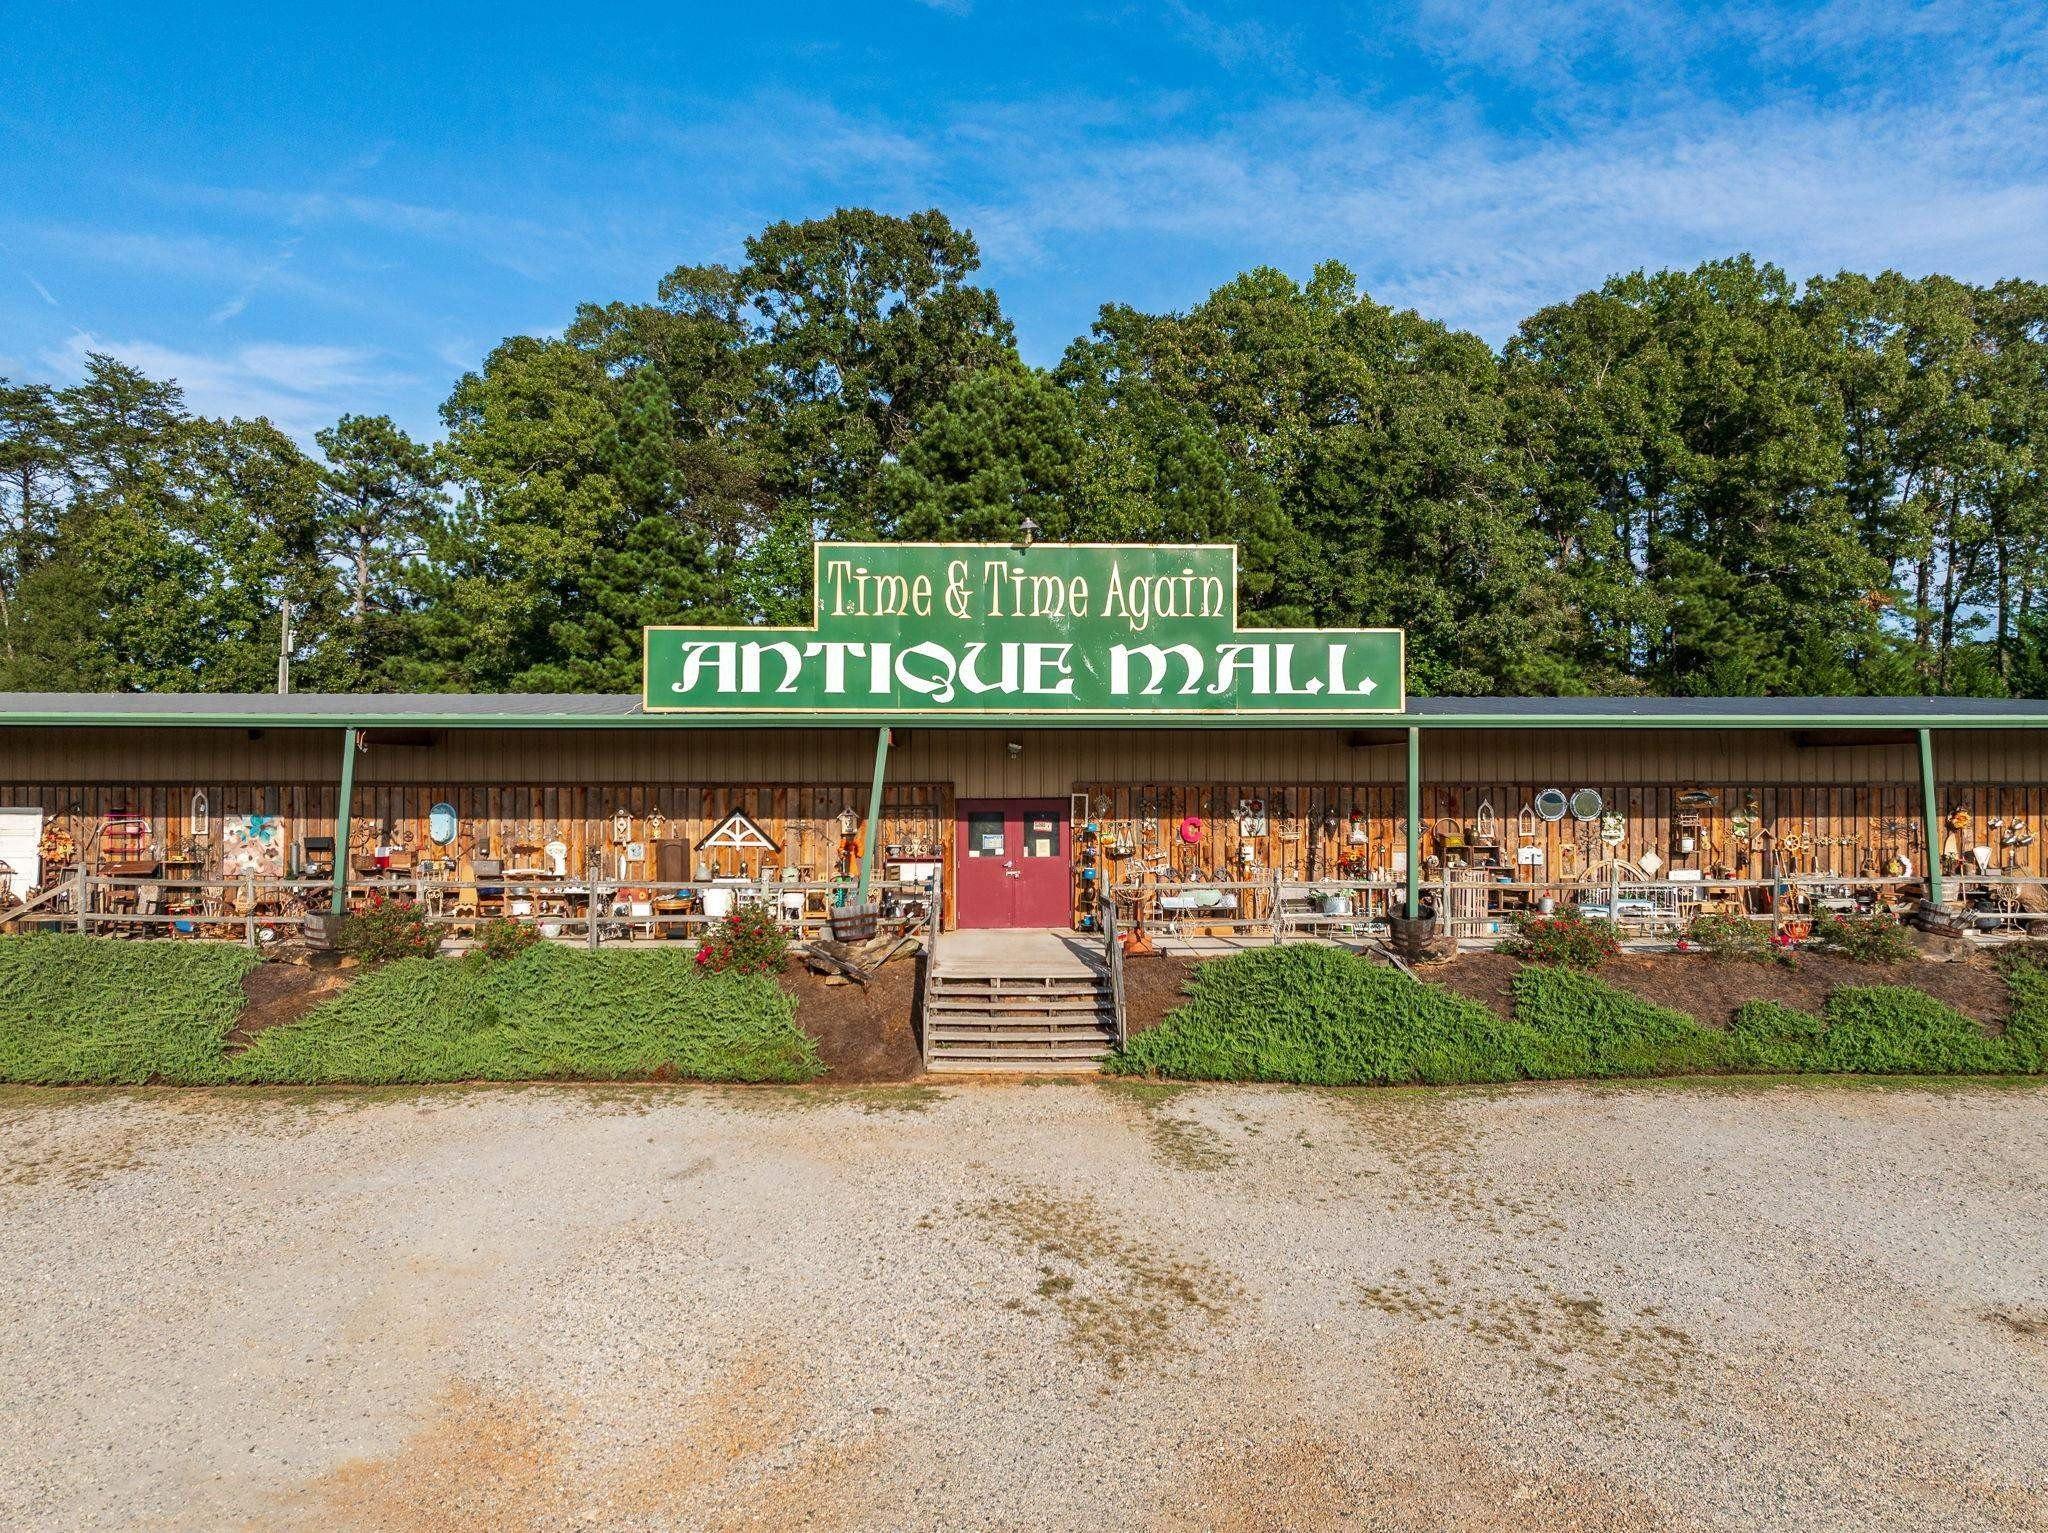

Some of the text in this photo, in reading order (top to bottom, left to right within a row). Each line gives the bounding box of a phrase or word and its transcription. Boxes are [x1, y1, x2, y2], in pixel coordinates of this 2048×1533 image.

[827, 559, 1224, 632] Time & Time Again
[671, 641, 1378, 704] ANTIQUE MALL
